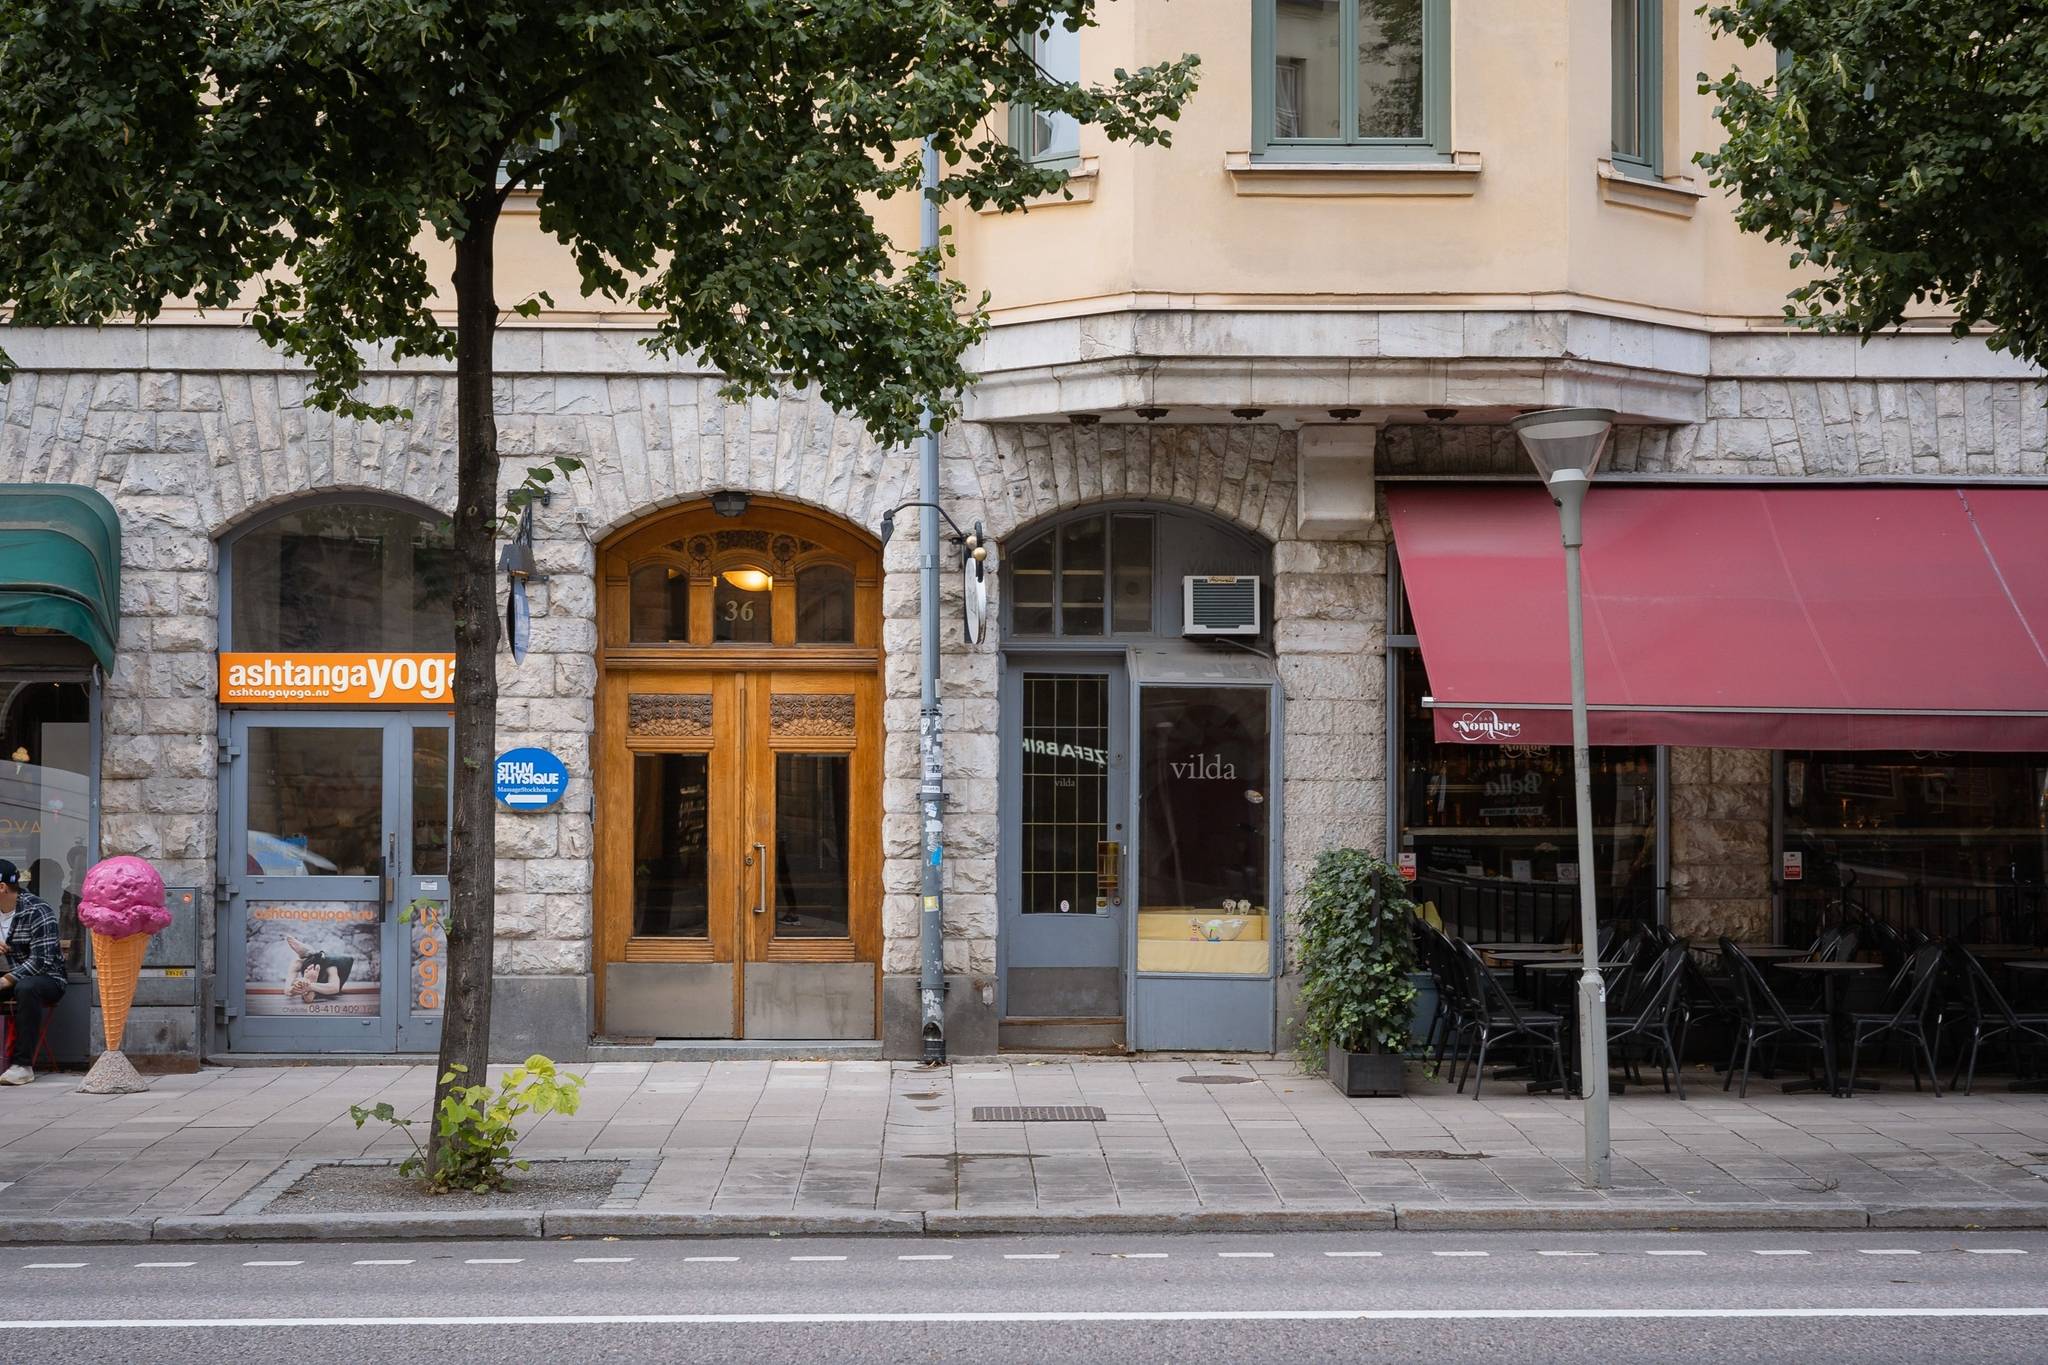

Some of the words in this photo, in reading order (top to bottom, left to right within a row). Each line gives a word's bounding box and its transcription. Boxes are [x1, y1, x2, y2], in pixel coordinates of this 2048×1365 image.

[724, 600, 754, 621] 36
[228, 688, 330, 698] ashtangayoga.nu
[1453, 710, 1521, 740] Nombre
[1170, 754, 1237, 780] vilda
[496, 773, 559, 785] PHYSIQUE
[1055, 778, 1076, 788] vilda
[255, 907, 375, 922] ashtangayoga.nu
